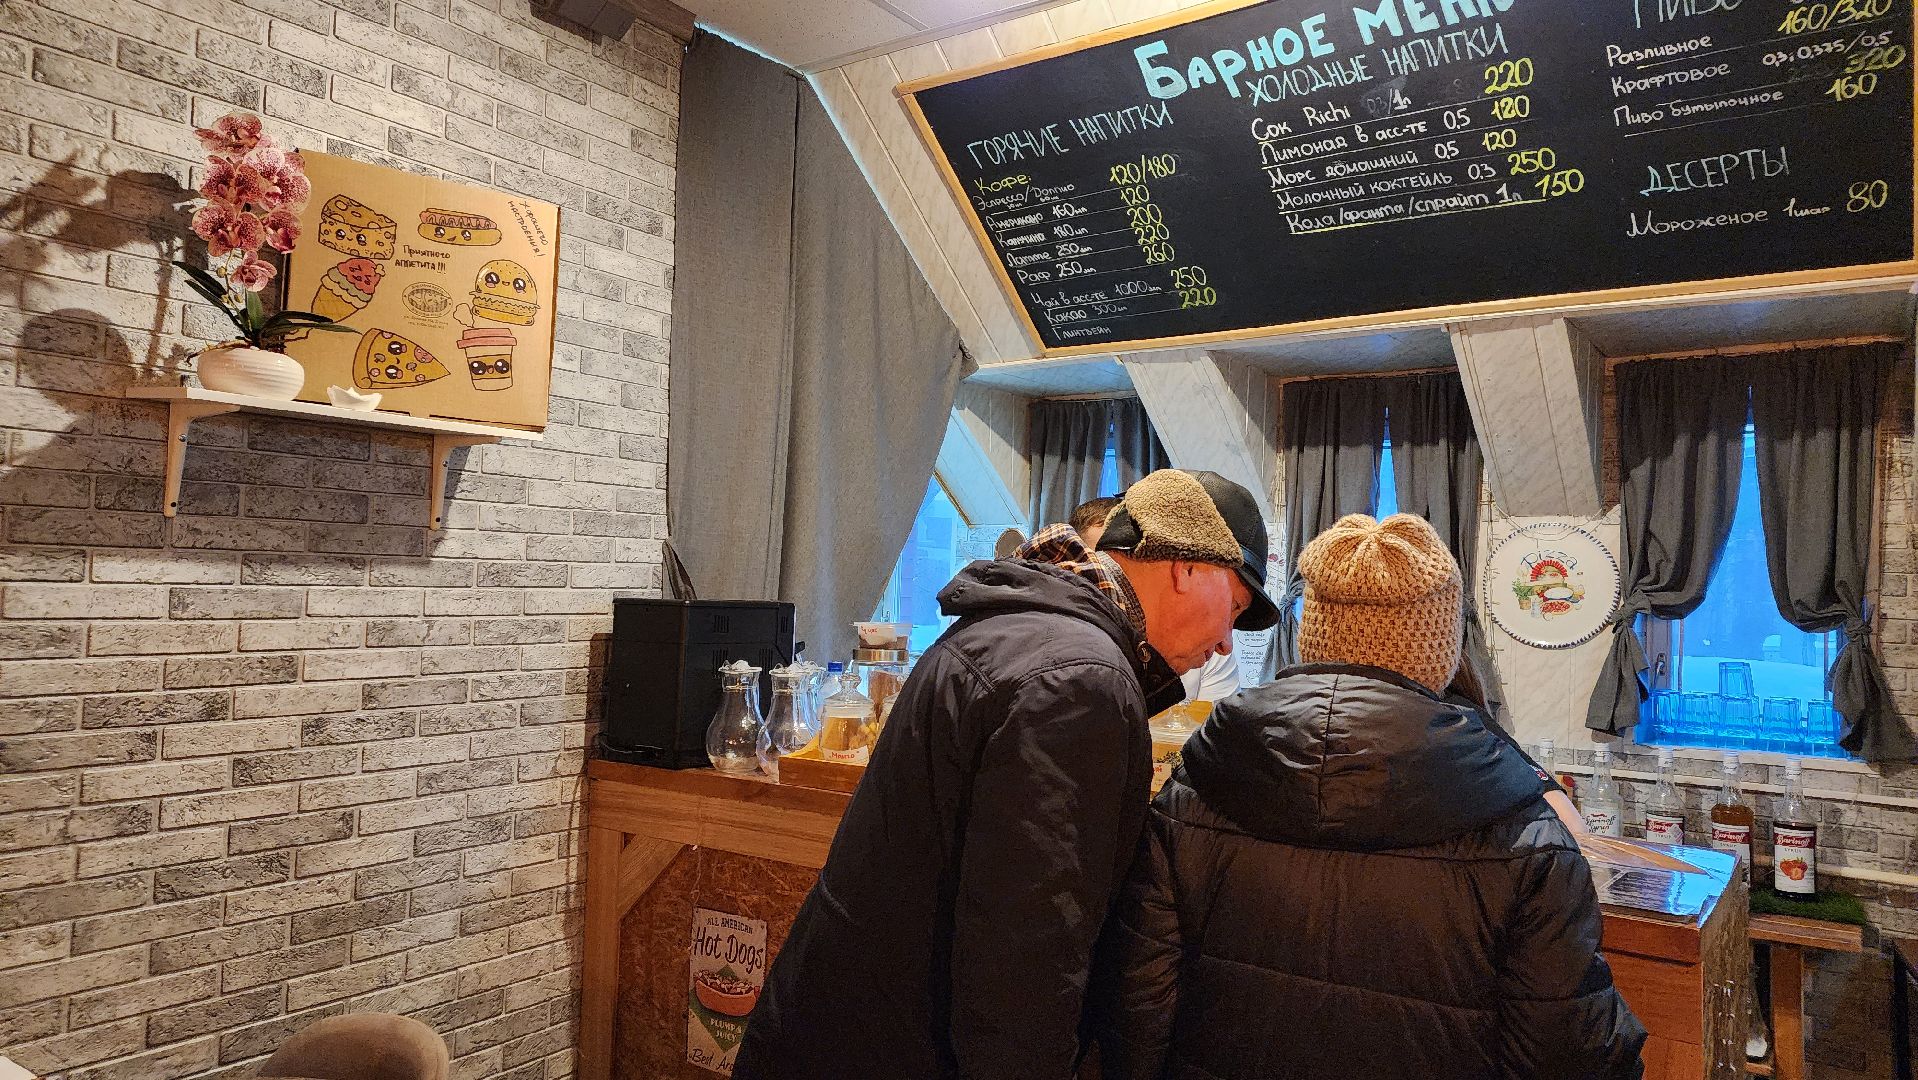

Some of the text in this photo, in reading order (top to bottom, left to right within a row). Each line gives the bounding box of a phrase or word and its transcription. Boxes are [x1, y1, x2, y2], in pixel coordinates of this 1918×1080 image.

[1246, 23, 1509, 107] ХОЛОДНЫЕ НАПИТКИ
[1606, 35, 1712, 67] Разливное
[1251, 116, 1292, 141] Сок
[1303, 101, 1351, 127] Richi
[1484, 57, 1534, 94] 220
[1611, 63, 1731, 97] Крафтовое
[1613, 72, 1878, 127] Пиво бутылочное 160
[966, 101, 1174, 169] ГОРЯЧИЕ НАПИТКИ
[1261, 138, 1348, 164] Лимонад
[1355, 124, 1368, 143] в
[1109, 153, 1177, 185] 120/180
[1268, 168, 1316, 191] Морс
[1326, 151, 1419, 178] домашний
[1481, 128, 1518, 151] 120
[1639, 147, 1790, 196] ДЕСЕРТЫ
[974, 175, 1032, 196] Кофе:
[1277, 182, 1366, 211] Молочный
[1507, 147, 1556, 176] 250
[1535, 168, 1585, 198] 150
[986, 213, 1044, 231] Американо
[1120, 185, 1150, 207] 120
[1127, 203, 1162, 227] 200
[1626, 210, 1769, 238] Мороженое
[1846, 179, 1889, 213] 80
[403, 245, 451, 259] Приятного
[1135, 223, 1170, 245] 220
[1016, 269, 1051, 285] Раф
[1143, 242, 1175, 264] 260
[1030, 292, 1060, 307] Чай
[1171, 266, 1206, 289] 250
[1044, 310, 1087, 324] Какао
[1179, 287, 1217, 310] 220
[721, 918, 753, 934] AMERICAN
[692, 927, 764, 974] Hot Dogs
[710, 1018, 736, 1031] PLUMP
[716, 1030, 737, 1042] JUICY
[689, 1048, 715, 1067] Best
